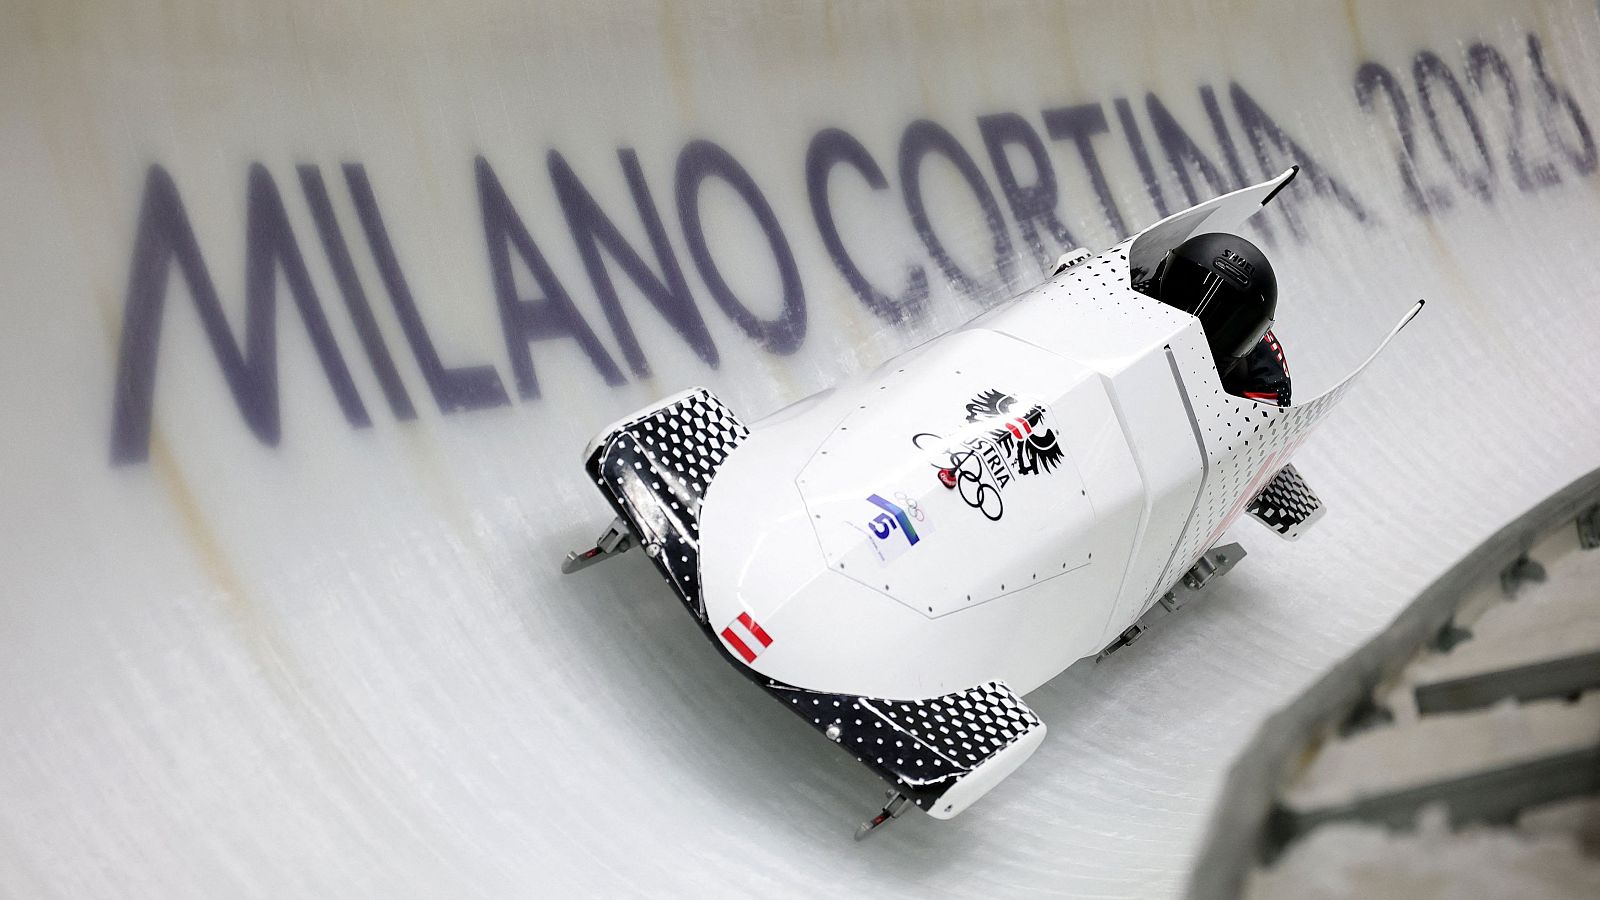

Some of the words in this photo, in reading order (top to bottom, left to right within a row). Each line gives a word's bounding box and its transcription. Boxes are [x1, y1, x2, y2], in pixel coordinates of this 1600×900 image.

[108, 138, 809, 467] MILANO
[804, 79, 1370, 328] CORTINA
[1354, 31, 1599, 217] 2026
[1221, 248, 1256, 277] SHOEI
[962, 436, 1011, 489] USTRIA
[868, 512, 898, 540] 5
